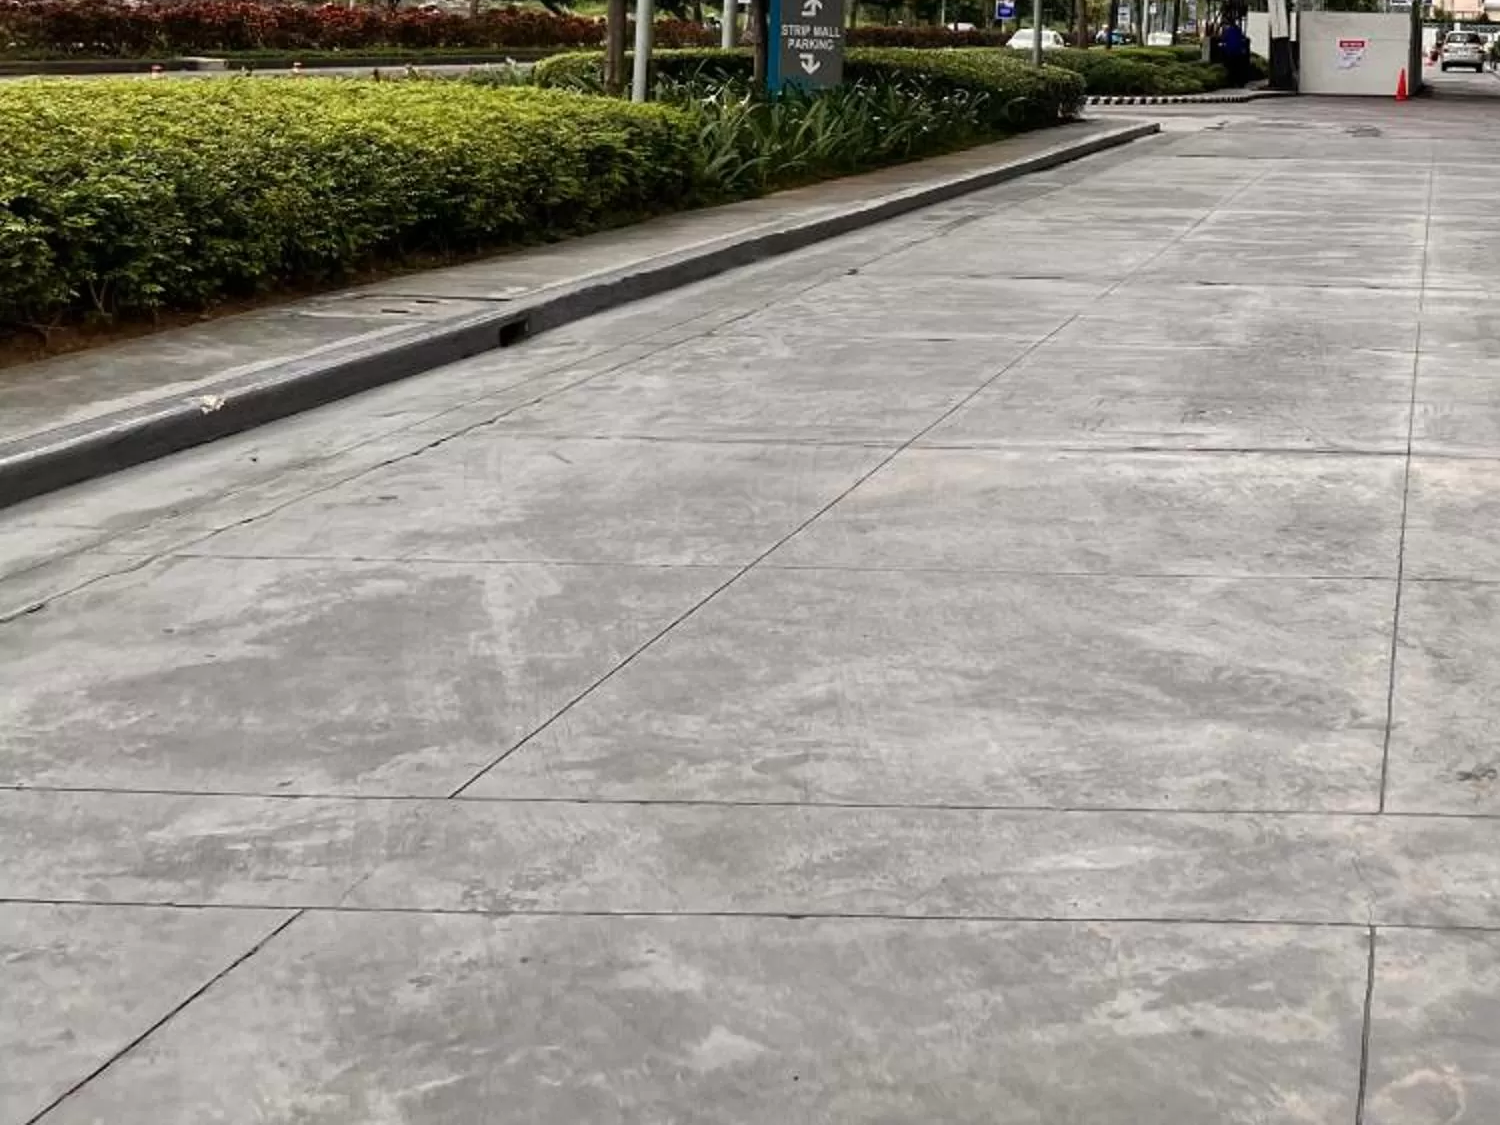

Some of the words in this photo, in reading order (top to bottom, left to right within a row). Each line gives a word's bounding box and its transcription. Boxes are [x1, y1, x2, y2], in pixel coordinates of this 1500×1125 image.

[781, 24, 811, 36] STRIP
[813, 26, 841, 38] MALL
[787, 38, 835, 52] PARKING
